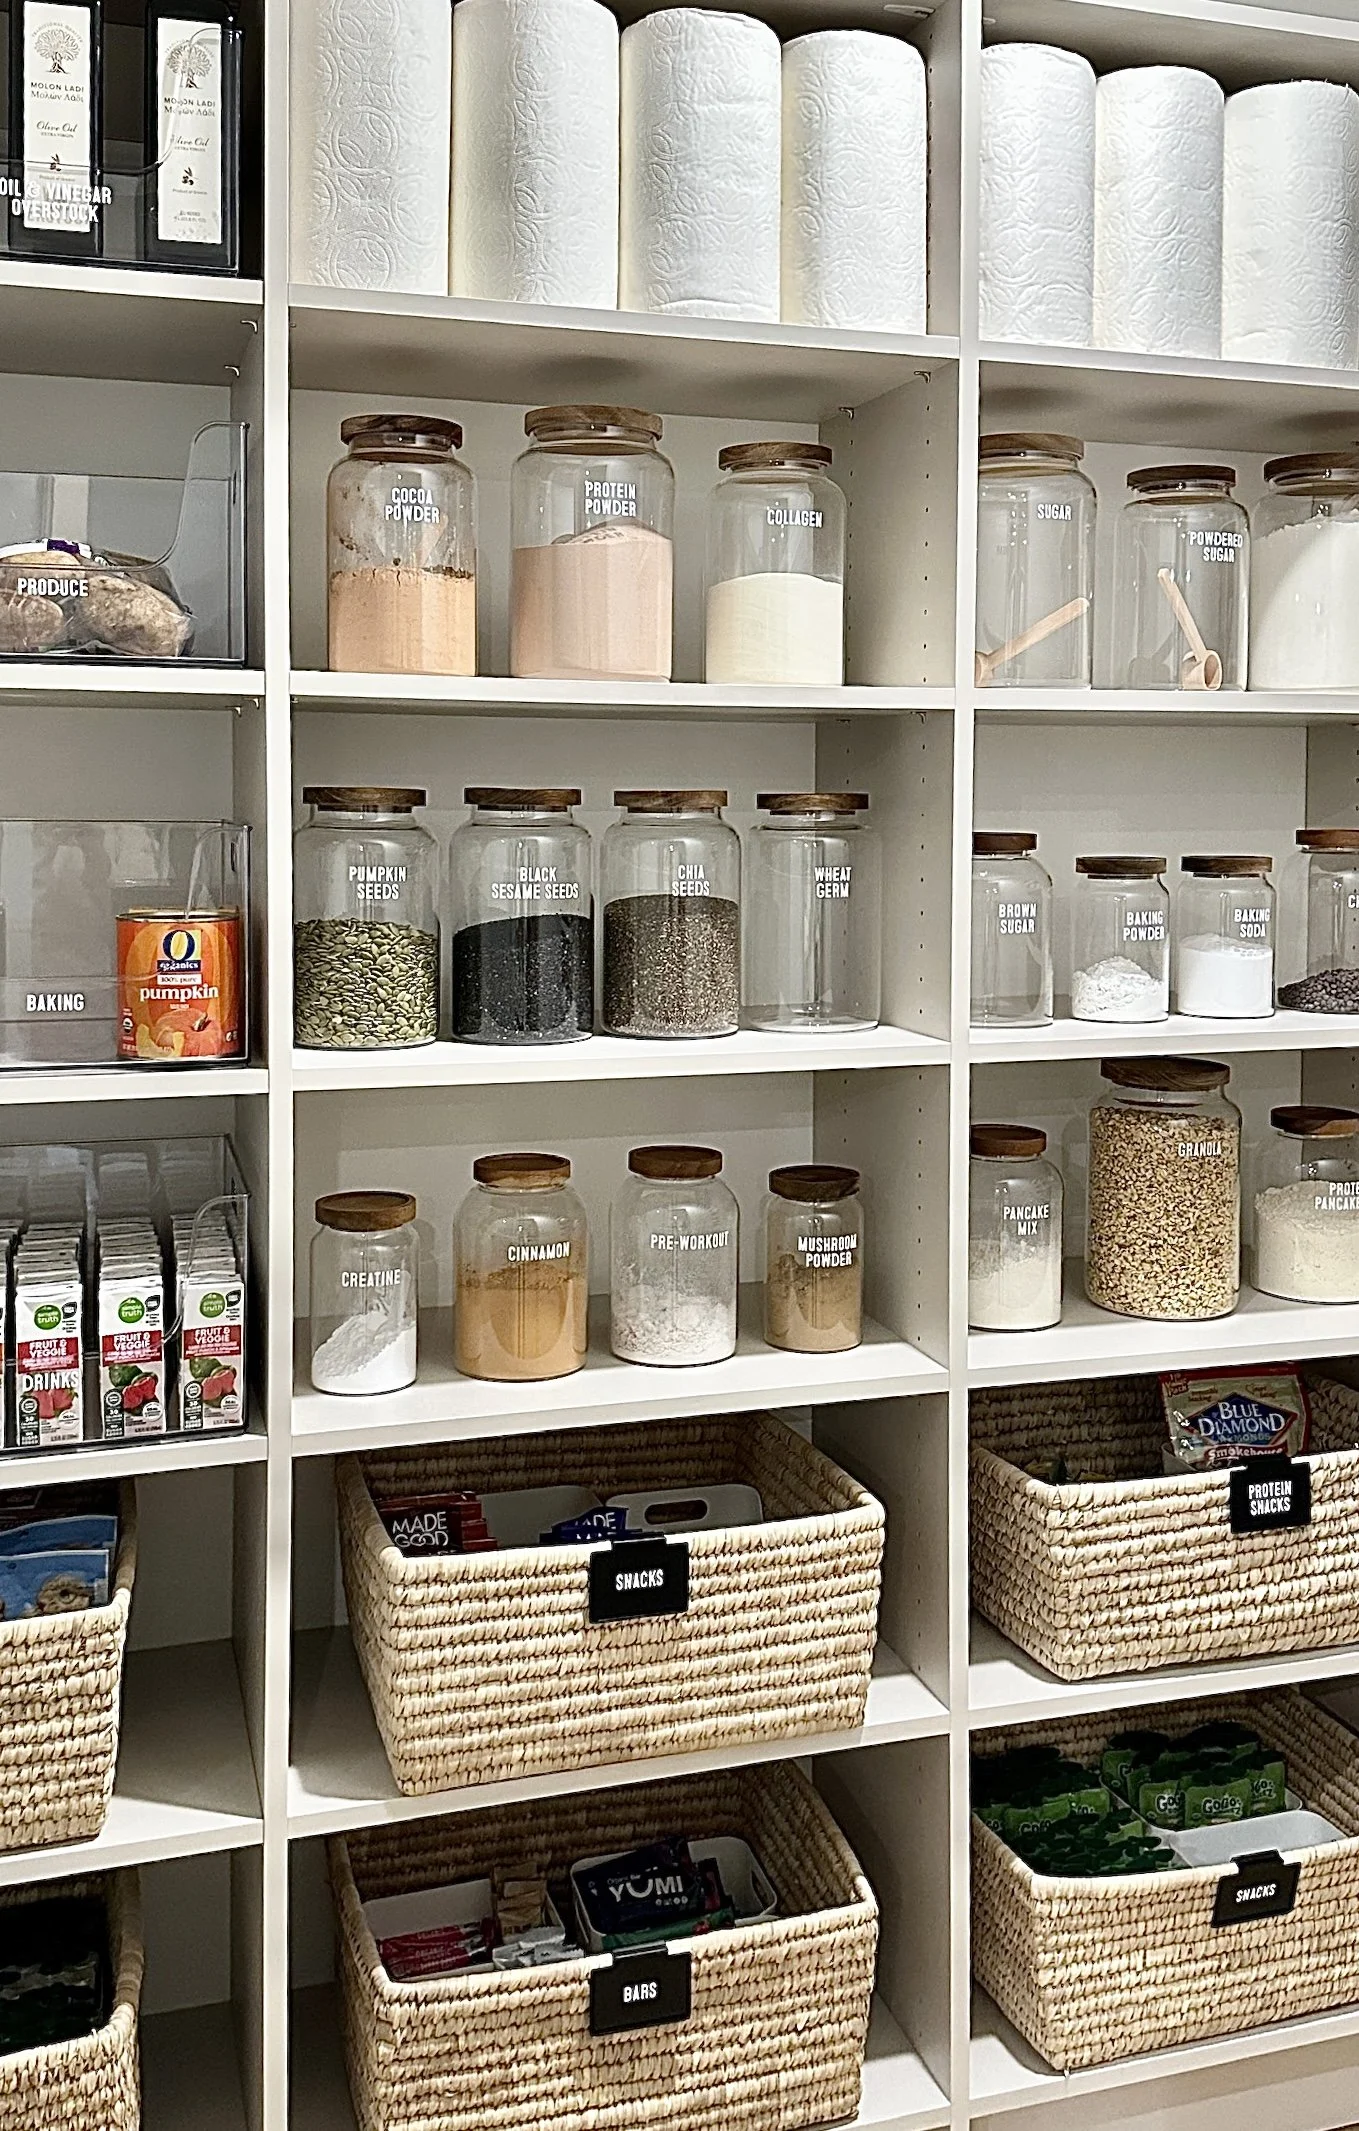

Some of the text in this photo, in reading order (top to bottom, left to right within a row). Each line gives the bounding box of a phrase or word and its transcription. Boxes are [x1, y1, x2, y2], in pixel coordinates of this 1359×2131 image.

[31, 82, 84, 92] MOLON LADI
[36, 120, 60, 132] Olive
[0, 178, 21, 196] OIL
[47, 182, 112, 204] VINEGAR
[12, 199, 98, 222] OVERSTOCK
[392, 488, 433, 504] COCOA
[585, 482, 636, 500] PROTEIN
[385, 504, 440, 524] POWDER
[584, 499, 636, 516] POWDER
[1038, 504, 1072, 520] SUGAR
[766, 510, 822, 528] COLLAGEN
[1189, 531, 1243, 548] POWDERED
[1203, 547, 1234, 562] SUGAR
[17, 578, 89, 596] PRODUCE
[349, 866, 406, 882] PUMPKIN
[520, 866, 557, 882] BLACK
[678, 864, 705, 880] CHIA
[814, 866, 852, 882] WHEAT
[357, 884, 400, 900] SEEDS
[492, 882, 579, 900] SESAME SEEDS
[672, 881, 710, 896] SEEDS
[816, 882, 849, 898] GERM
[999, 904, 1036, 918] BROWN
[1126, 910, 1164, 926] BAKING
[1234, 908, 1270, 922] BAKING
[1000, 919, 1035, 934] SUGAR
[1123, 926, 1164, 942] POWDER
[1240, 924, 1266, 938] SODA
[139, 983, 219, 1002] pumpkin
[26, 993, 84, 1012] BAKING
[1178, 1142, 1222, 1158] GRANOLA
[1004, 1204, 1050, 1221] PANCAKE
[1017, 1221, 1038, 1236] MIX
[650, 1230, 729, 1250] PRE-WORKOUT
[798, 1233, 858, 1252] MUSHROOM
[508, 1242, 571, 1262] CINNAMON
[805, 1250, 852, 1268] POWDER
[341, 1268, 400, 1288] CREATINE
[203, 1304, 223, 1312] truth
[38, 1316, 59, 1324] truth
[114, 1332, 142, 1342] FRUIT
[194, 1327, 222, 1337] FRUIT
[194, 1334, 230, 1344] VEGGIE
[29, 1340, 58, 1350] FRUIT
[29, 1348, 67, 1358] VEGGIE
[114, 1340, 150, 1351] VEGGIE
[22, 1371, 78, 1392] DRINKS
[1218, 1402, 1262, 1420] BLUE
[1198, 1413, 1286, 1436] DIAMOND
[1248, 1480, 1292, 1500] PROTEIN
[1250, 1497, 1290, 1516] SNACKS
[392, 1511, 448, 1534] MADE
[394, 1530, 448, 1548] GOOD
[616, 1568, 664, 1592] SNACKS
[608, 1876, 684, 1902] YUMI
[1236, 1884, 1276, 1902] SNACKS
[623, 1982, 658, 2004] BARS
